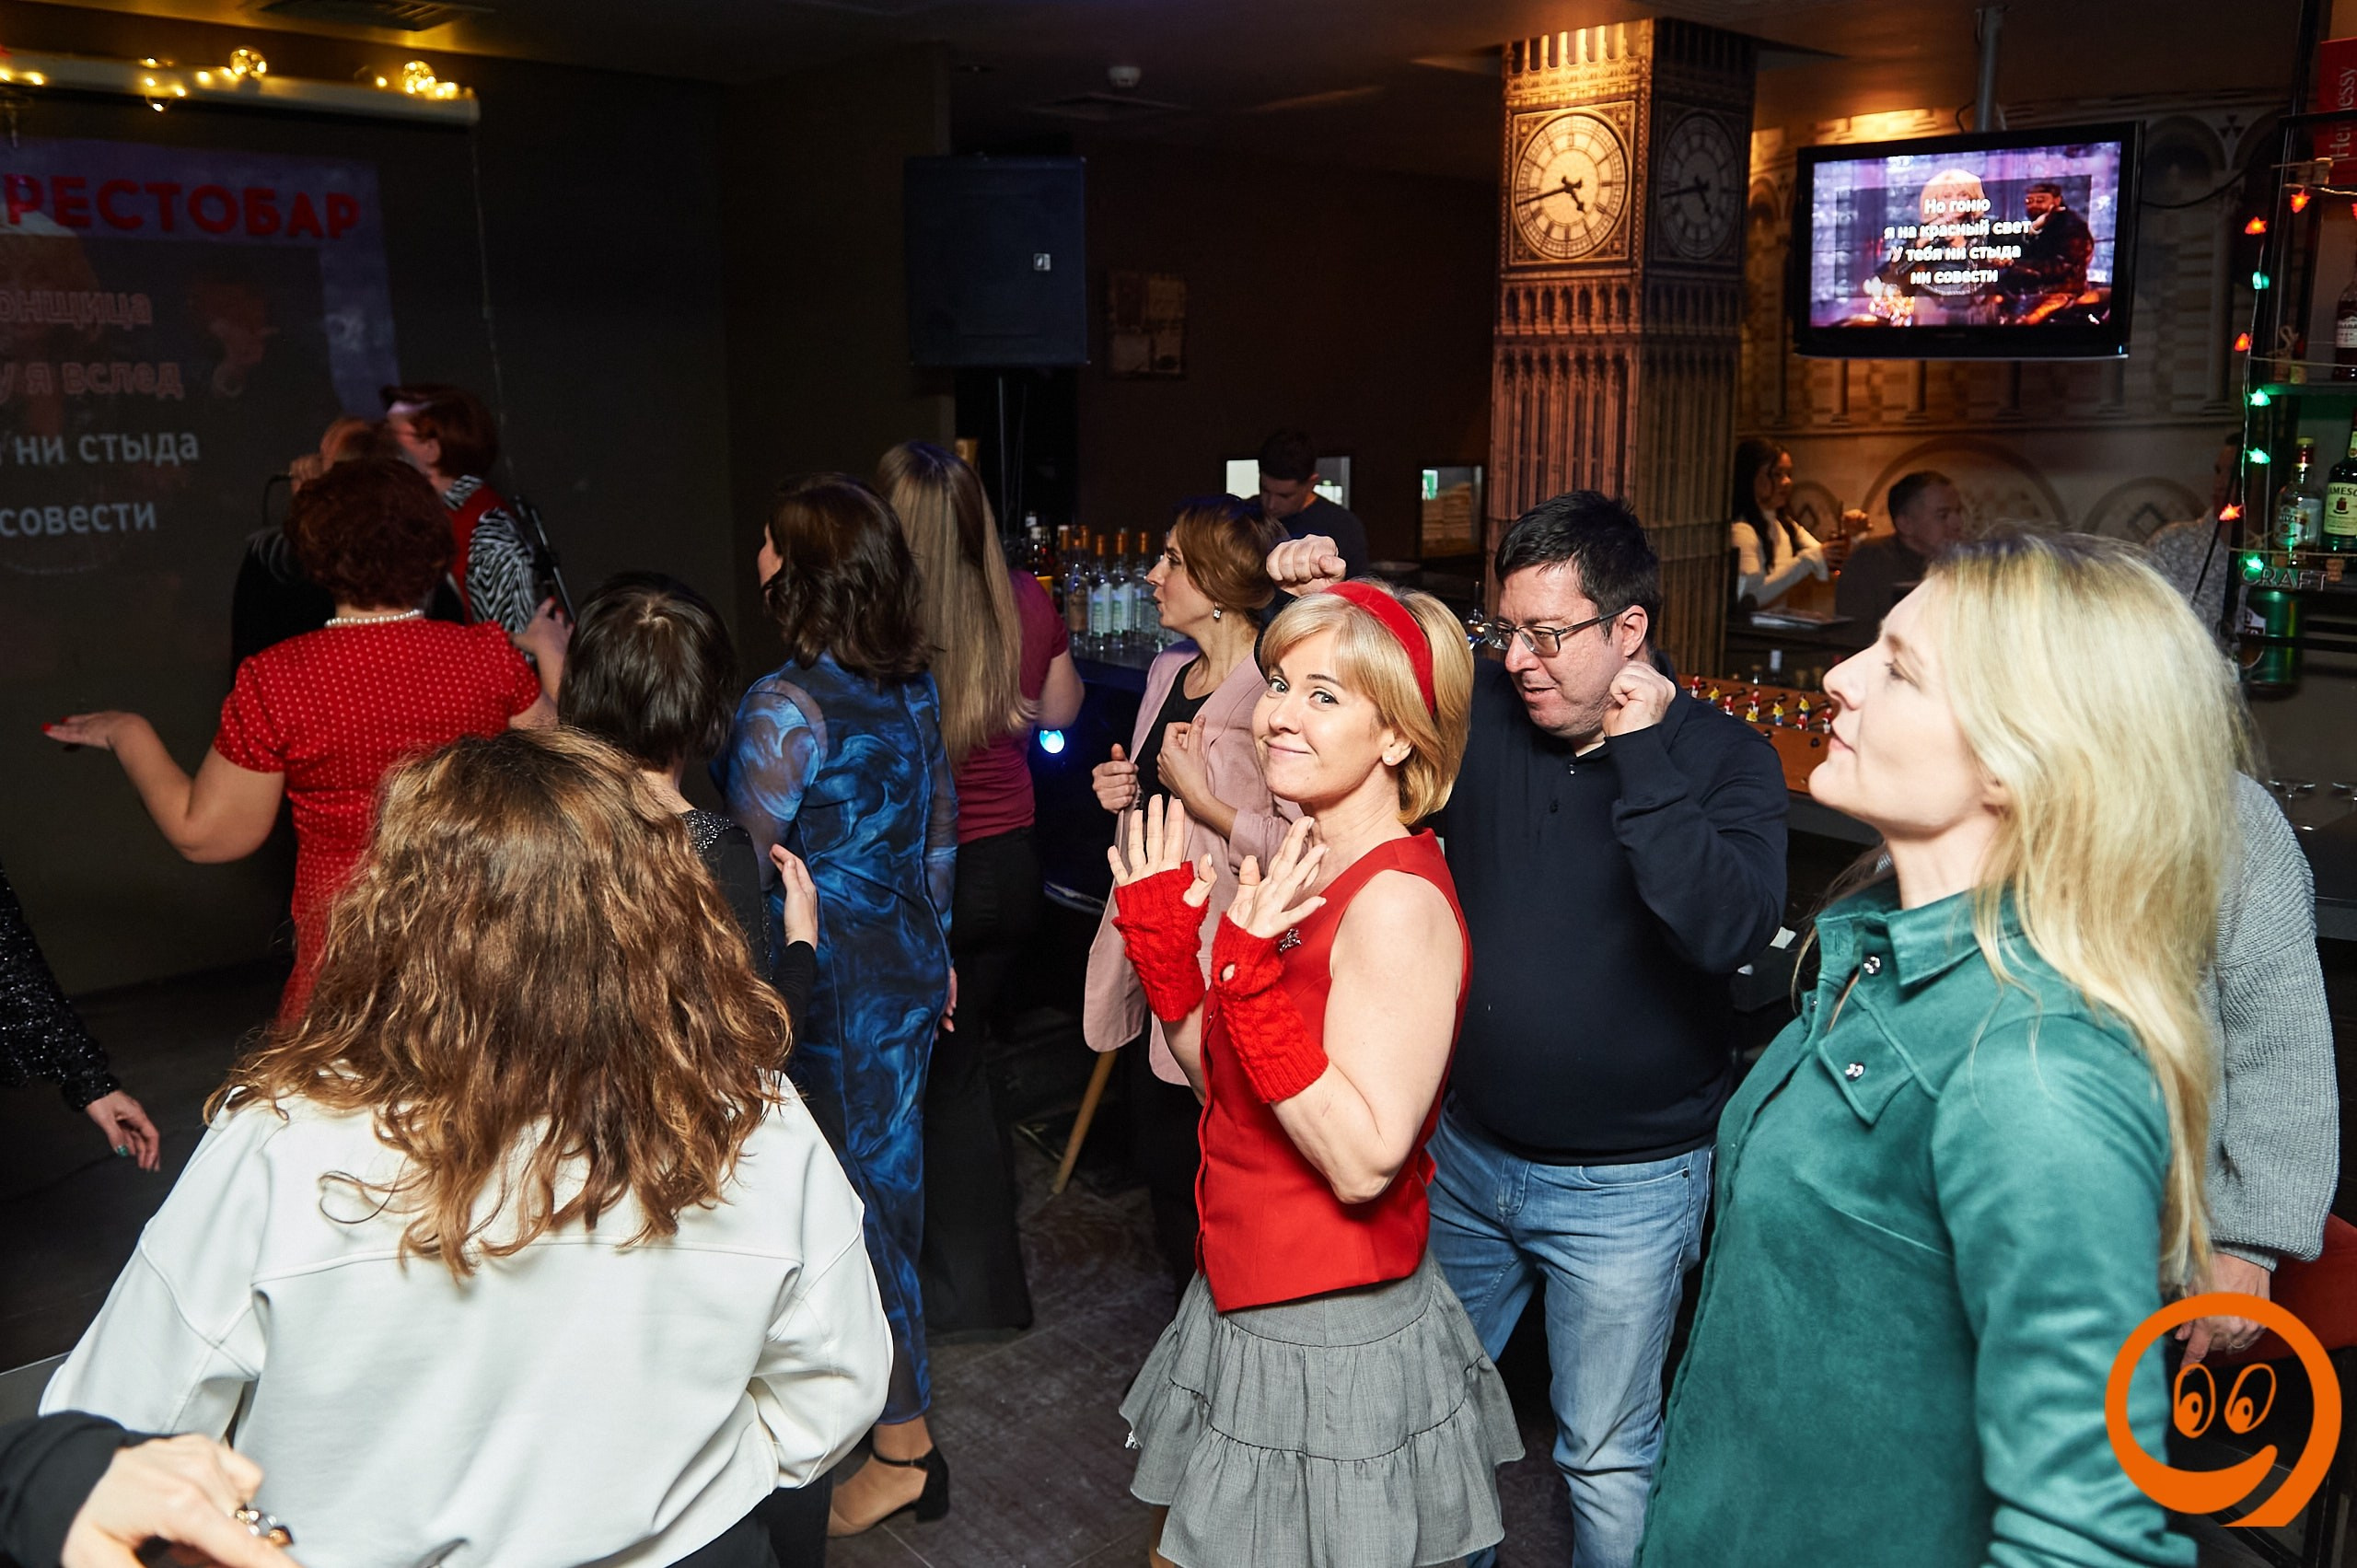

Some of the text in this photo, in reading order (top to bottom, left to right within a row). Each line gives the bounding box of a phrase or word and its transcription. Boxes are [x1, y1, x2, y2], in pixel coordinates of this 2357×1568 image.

[2328, 66, 2357, 159] Heessy
[4, 174, 360, 238] РЕСТОБАР
[1924, 197, 1991, 215] Но гоню
[1884, 219, 2032, 240] я на красный свет
[1905, 246, 1943, 261] тебя
[1945, 247, 1967, 261] ни
[1969, 245, 2022, 261] стыда
[1910, 269, 1999, 285] ни совести
[25, 361, 53, 396] я
[61, 361, 185, 400] вслед
[15, 434, 65, 466] ни
[78, 431, 200, 468] стыда
[0, 501, 157, 538] совести
[2240, 566, 2328, 592] CRAFT
